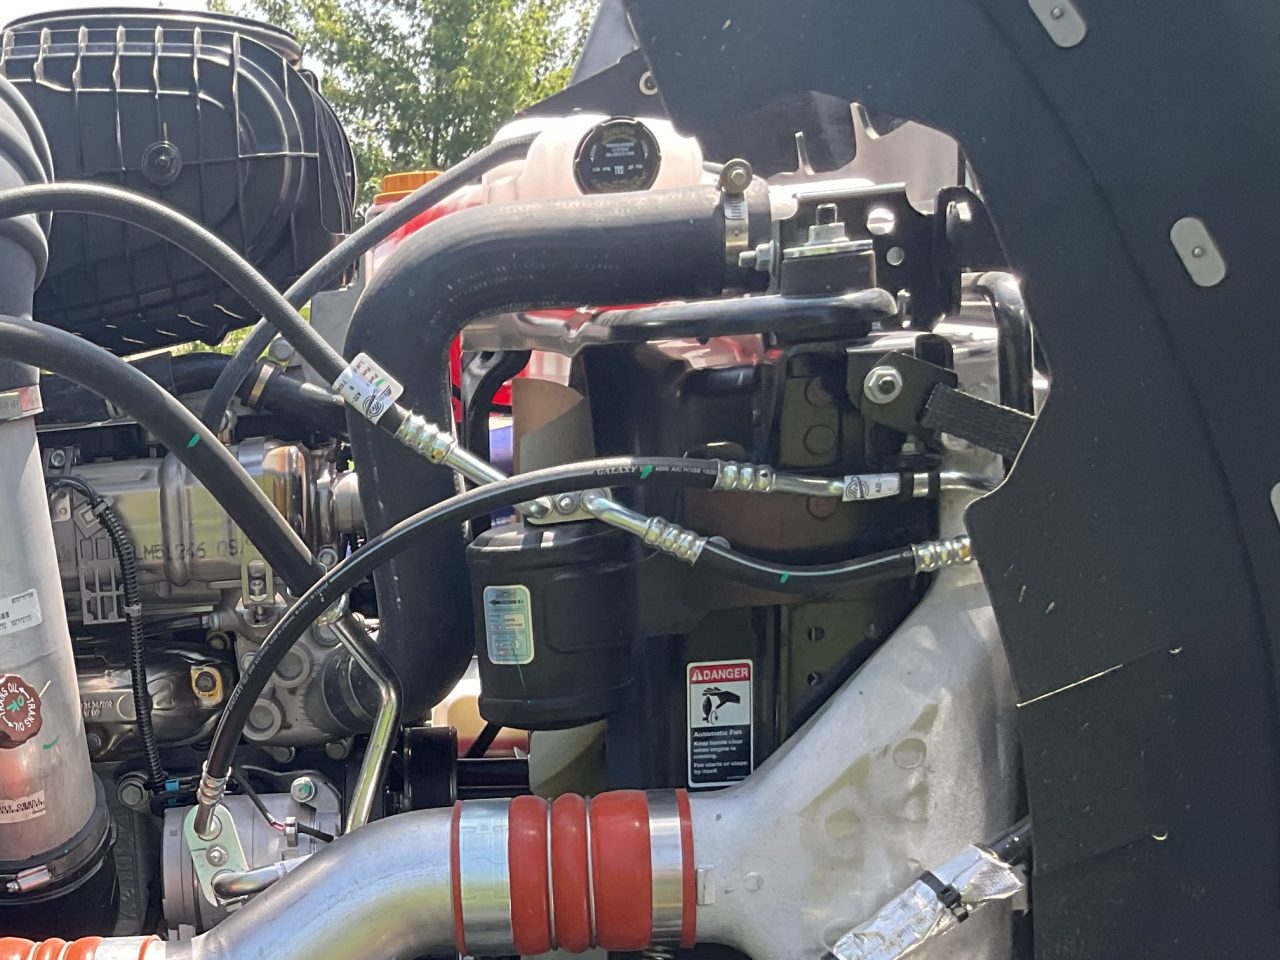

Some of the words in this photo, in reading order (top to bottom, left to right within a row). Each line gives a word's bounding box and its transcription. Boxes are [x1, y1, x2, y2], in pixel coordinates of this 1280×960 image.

[596, 465, 638, 476] GALAXY
[703, 667, 749, 681] DANGER
[8, 682, 19, 693] OIL
[24, 697, 36, 728] TRANS
[14, 722, 24, 732] OIL
[16, 798, 40, 808] TURBO
